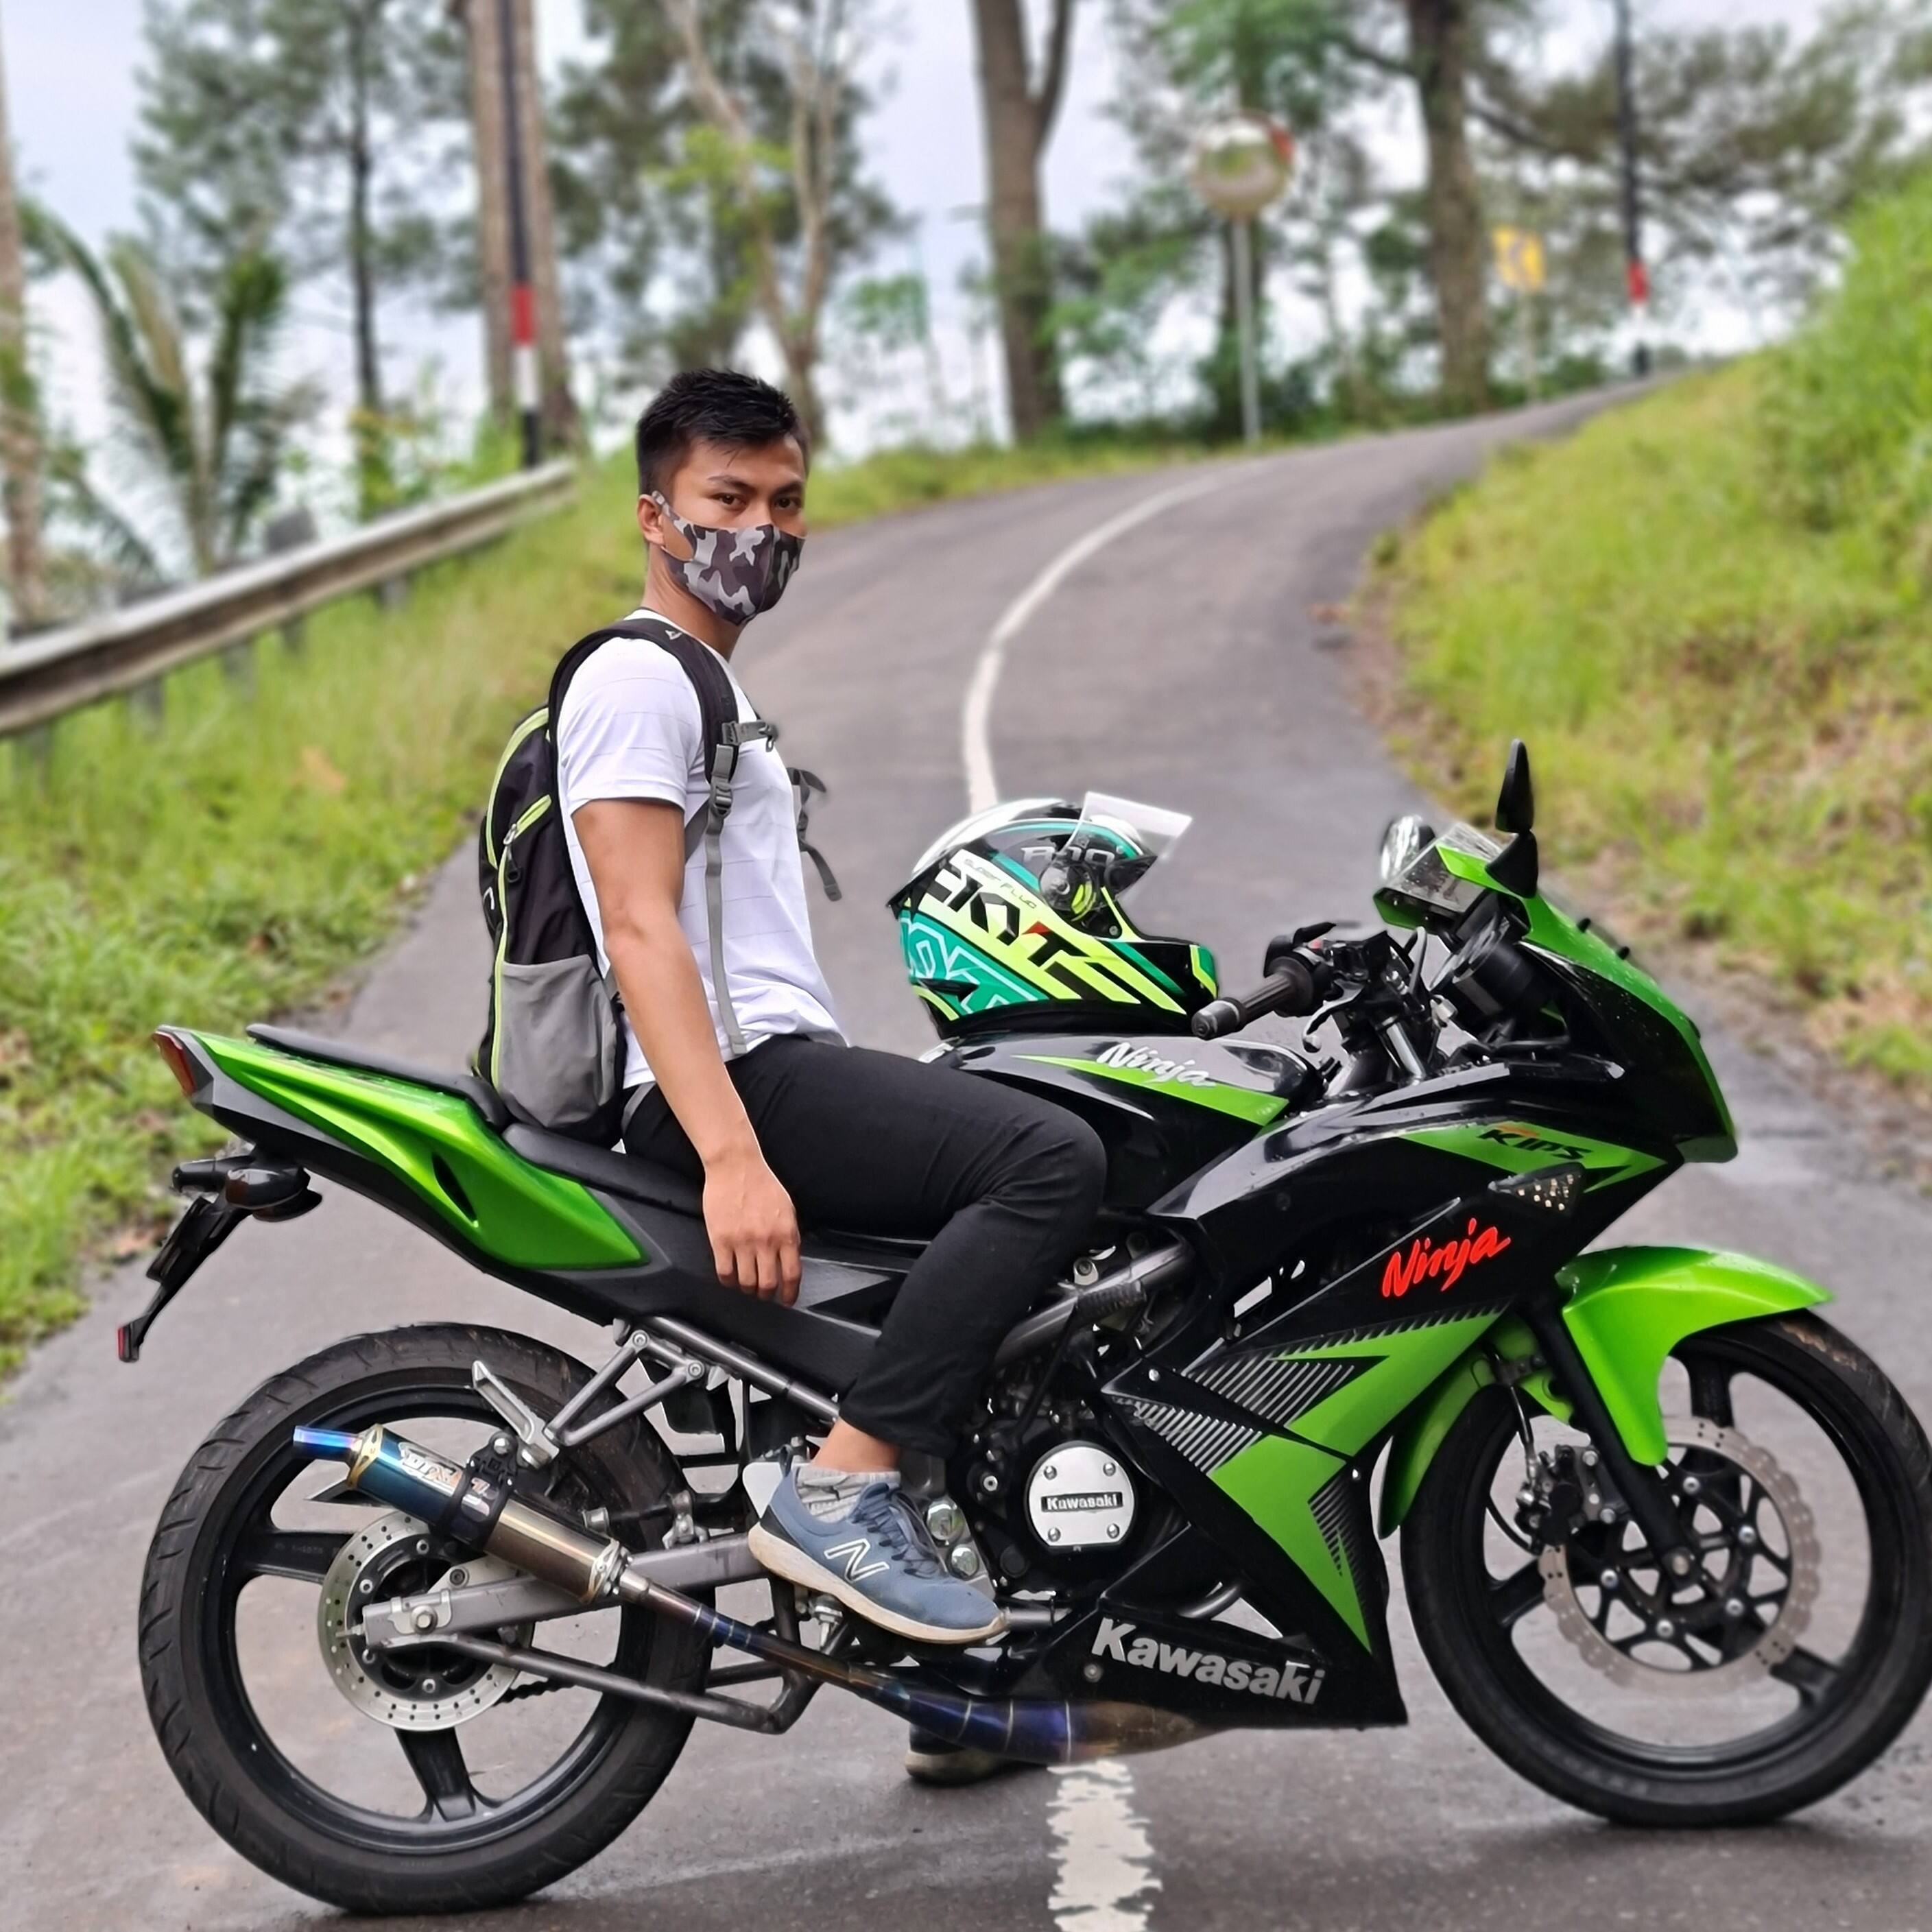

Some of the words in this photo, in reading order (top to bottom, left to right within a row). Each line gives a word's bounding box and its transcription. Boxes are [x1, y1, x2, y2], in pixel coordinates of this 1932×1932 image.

[1096, 1042, 1217, 1087] Ninja
[1381, 1217, 1512, 1298] Ninja
[1046, 1493, 1118, 1511] Kawasaki
[1090, 1617, 1326, 1705] Kawasaki
